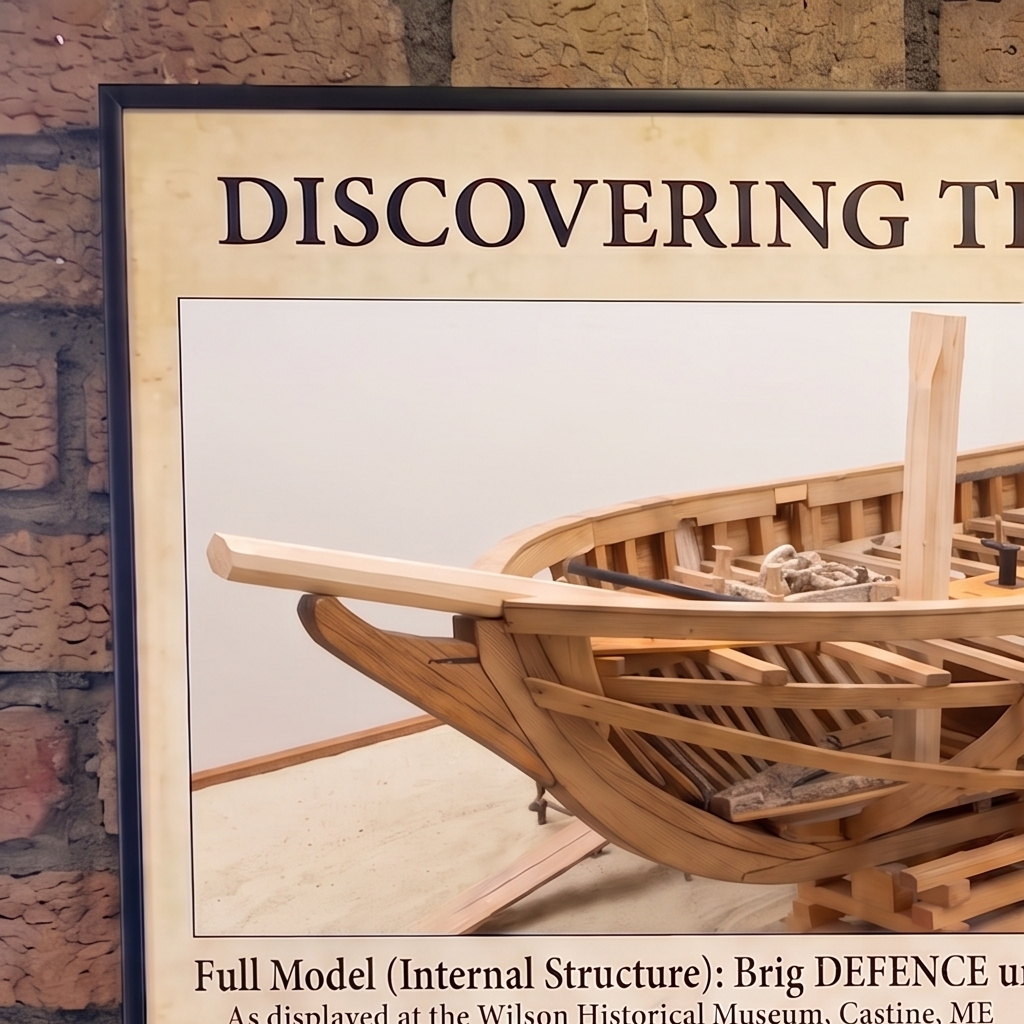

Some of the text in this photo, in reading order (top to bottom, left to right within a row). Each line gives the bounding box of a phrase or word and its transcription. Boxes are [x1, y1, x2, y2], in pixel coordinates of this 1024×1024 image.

[216, 176, 910, 250] DISCOVERING
[194, 956, 262, 992] Full
[269, 956, 377, 991] Model
[387, 955, 535, 997] (Internal
[544, 954, 723, 995] Structure):
[733, 956, 805, 999] Brig
[814, 954, 989, 988] DEFENCE
[949, 1001, 994, 1024] ME
